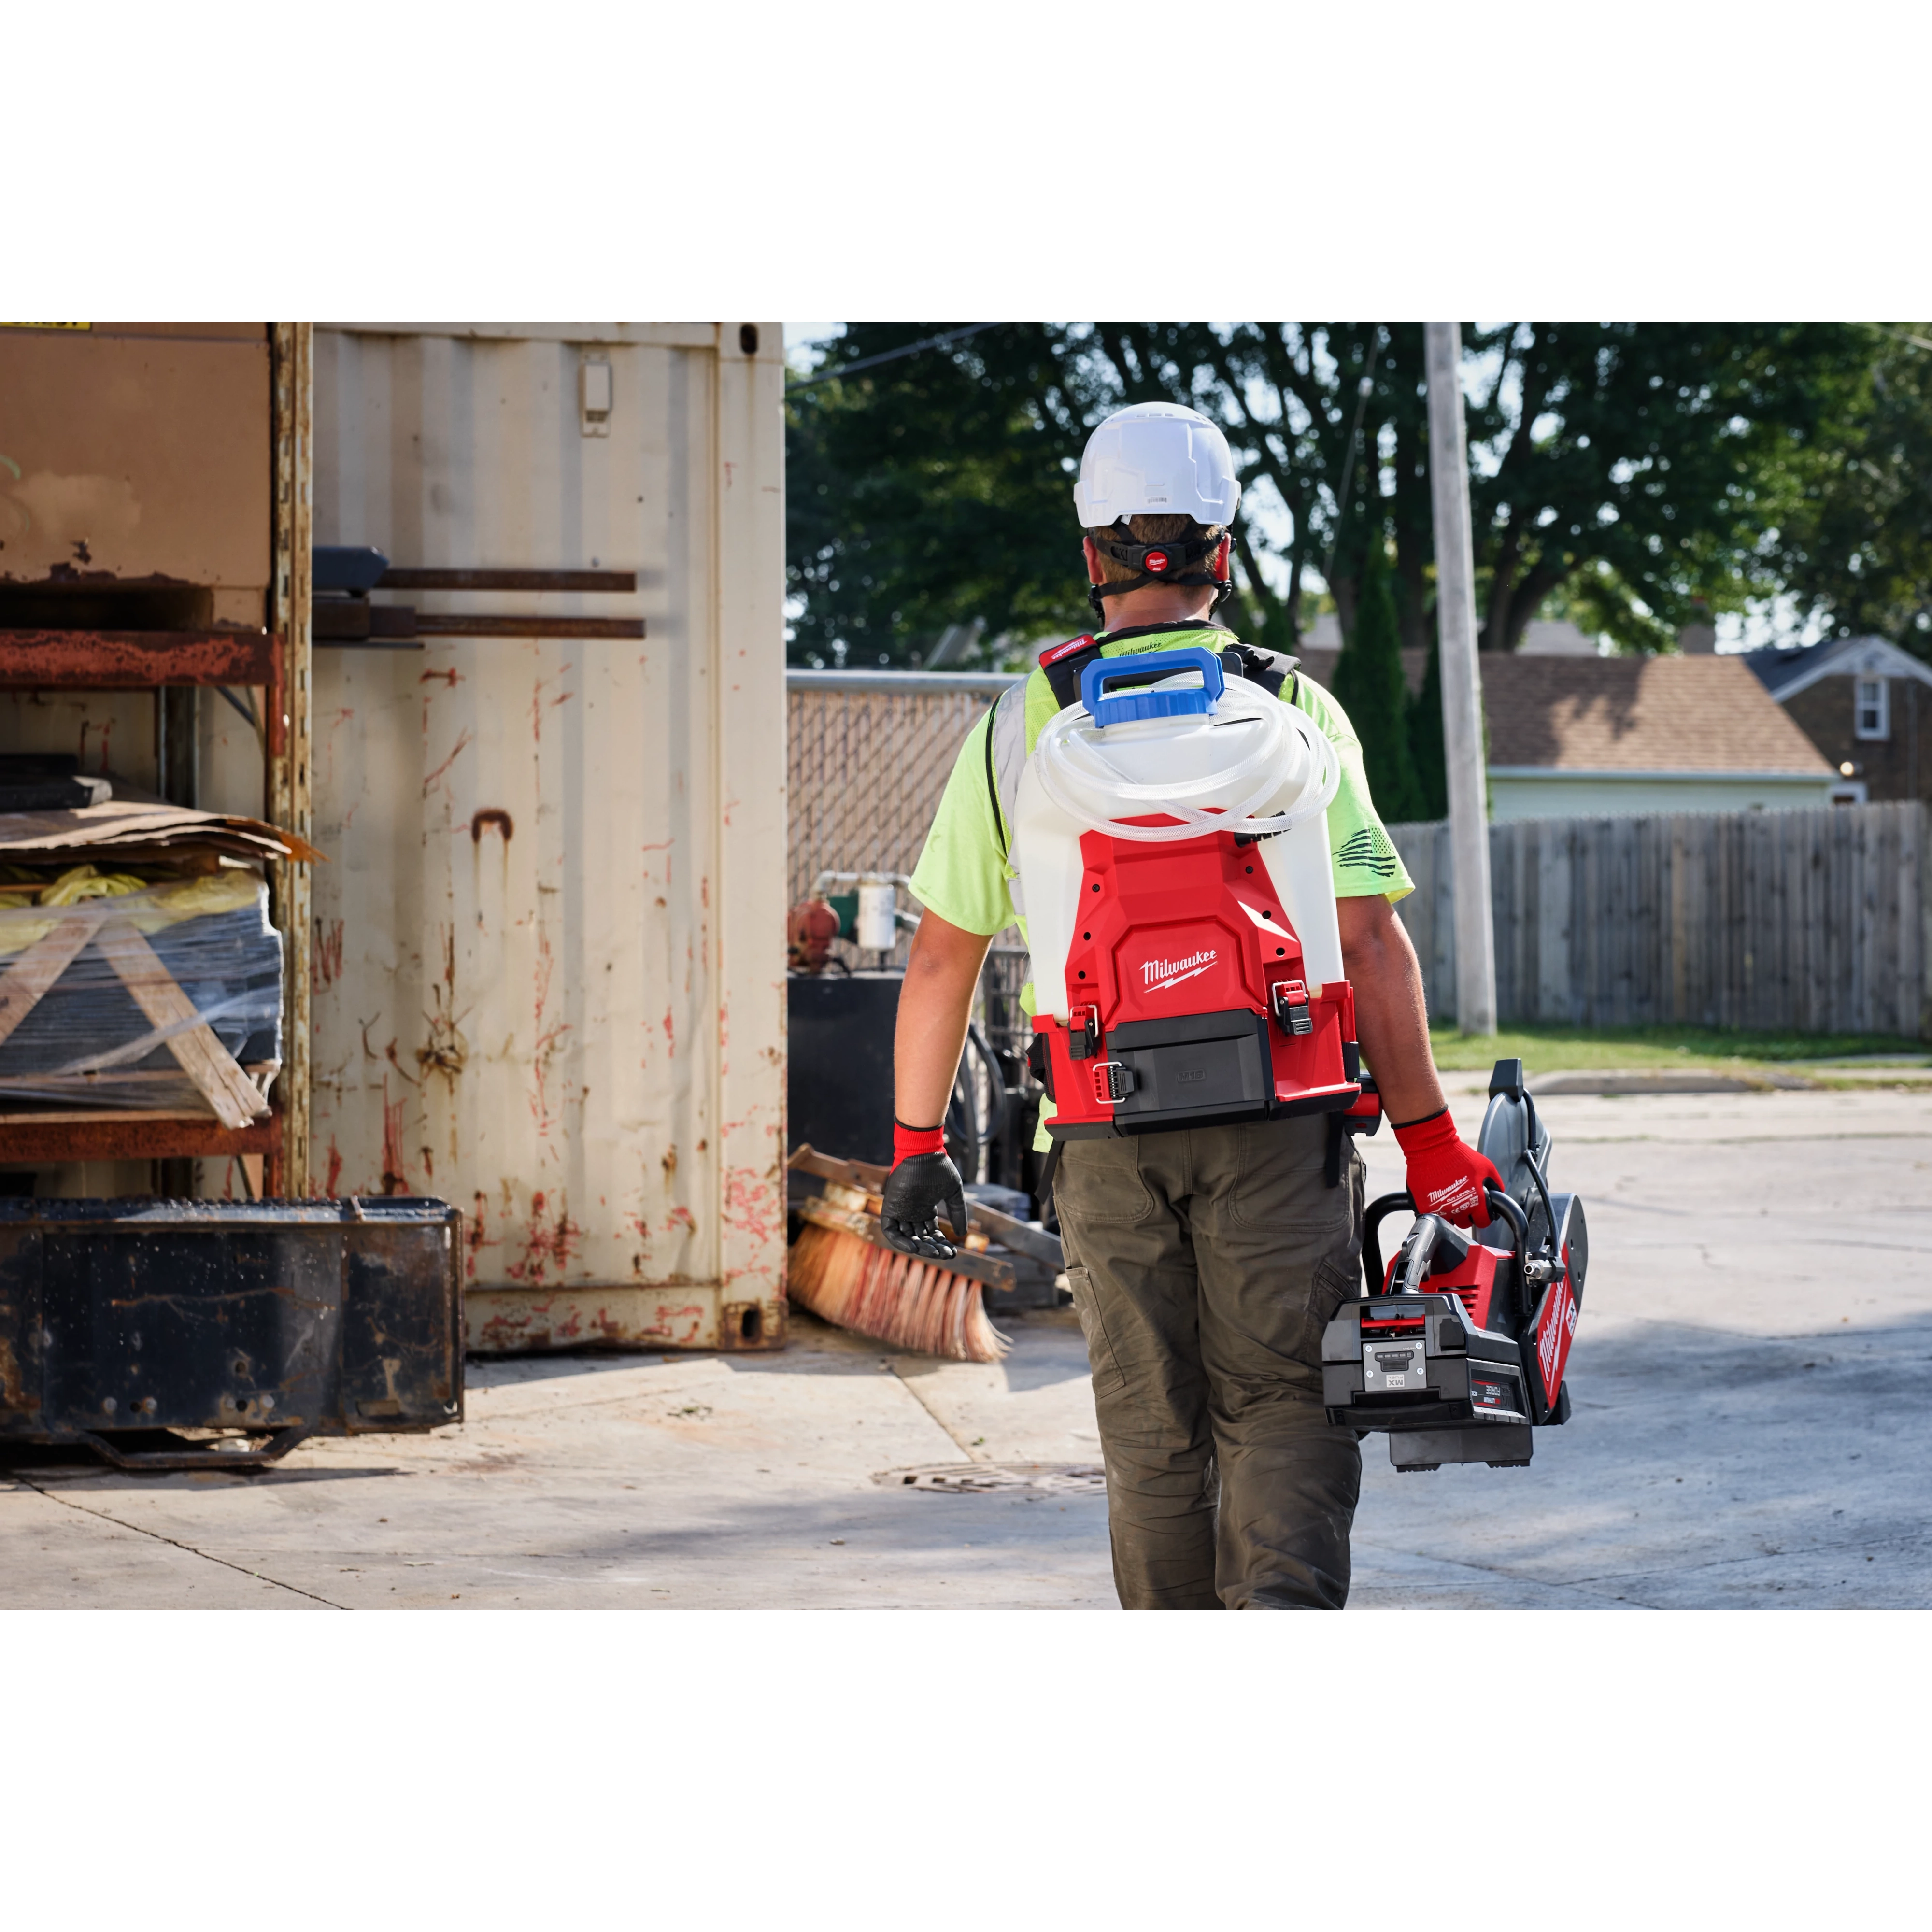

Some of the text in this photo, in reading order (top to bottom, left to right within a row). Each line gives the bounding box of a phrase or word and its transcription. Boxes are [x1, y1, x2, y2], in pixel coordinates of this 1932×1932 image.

[1138, 950, 1217, 985] Milwaukee
[1456, 1189, 1471, 1198] LEVEL
[1540, 1276, 1565, 1382] Milwauk
[1486, 1385, 1501, 1396] FORGE
